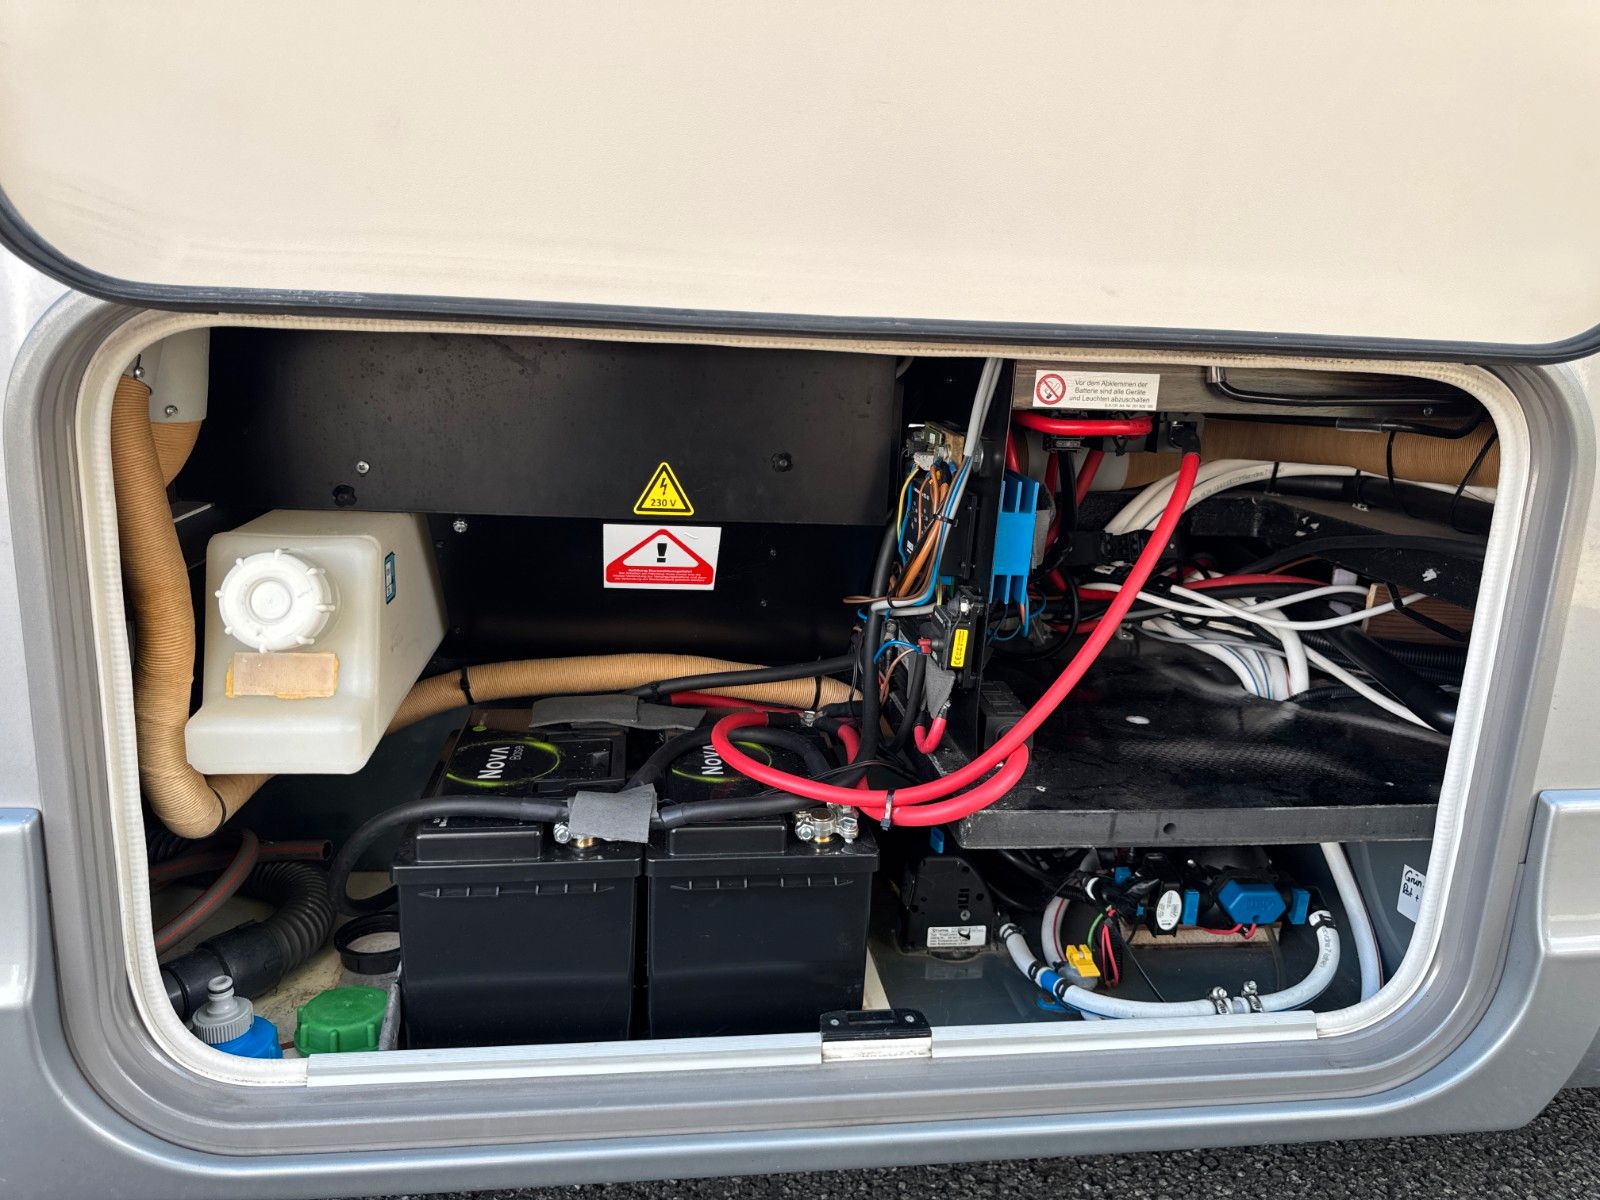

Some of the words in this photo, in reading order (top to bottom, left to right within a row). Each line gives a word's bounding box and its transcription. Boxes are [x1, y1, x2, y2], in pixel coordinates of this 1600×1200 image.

[650, 499, 667, 507] 230
[670, 499, 676, 507] V
[477, 746, 510, 779] NOVA
